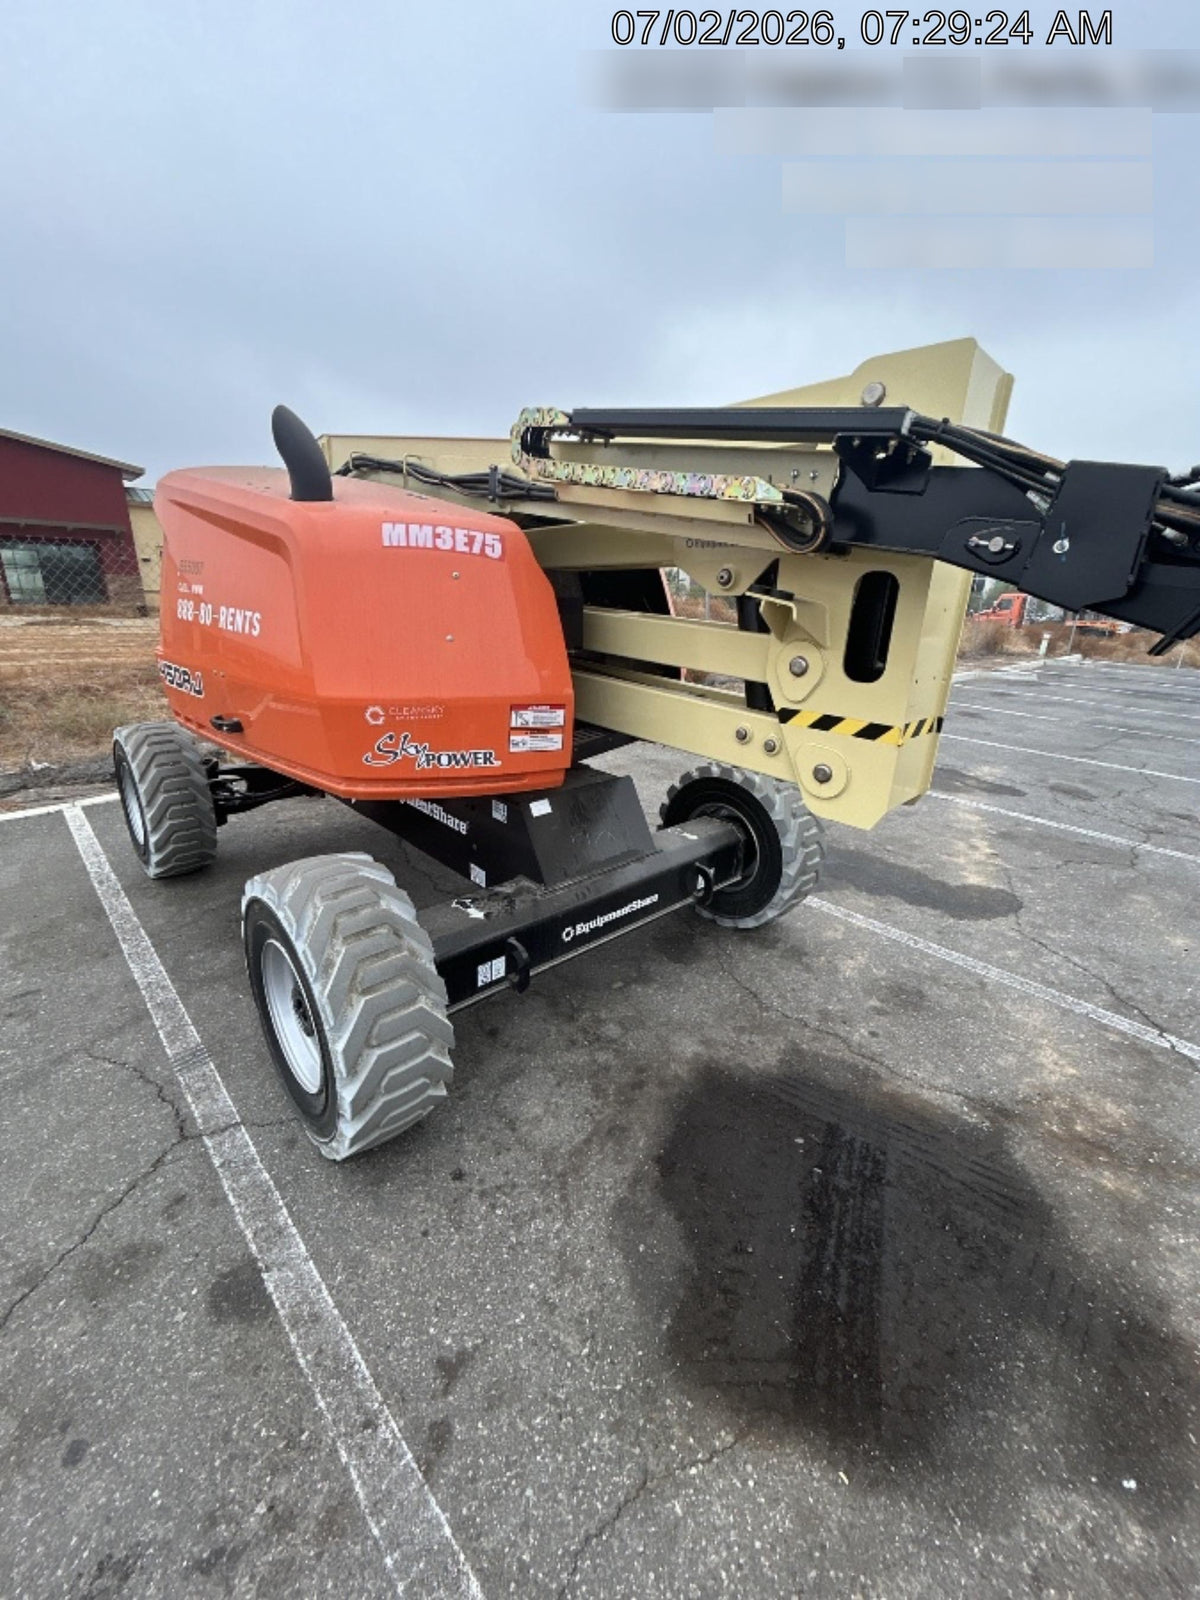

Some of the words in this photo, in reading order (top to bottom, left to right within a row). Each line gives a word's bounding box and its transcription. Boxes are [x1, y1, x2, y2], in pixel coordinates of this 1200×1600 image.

[381, 521, 503, 559] MM3E75
[177, 598, 262, 637] 888-80-RENTS
[575, 893, 659, 934] EquipmentShare
